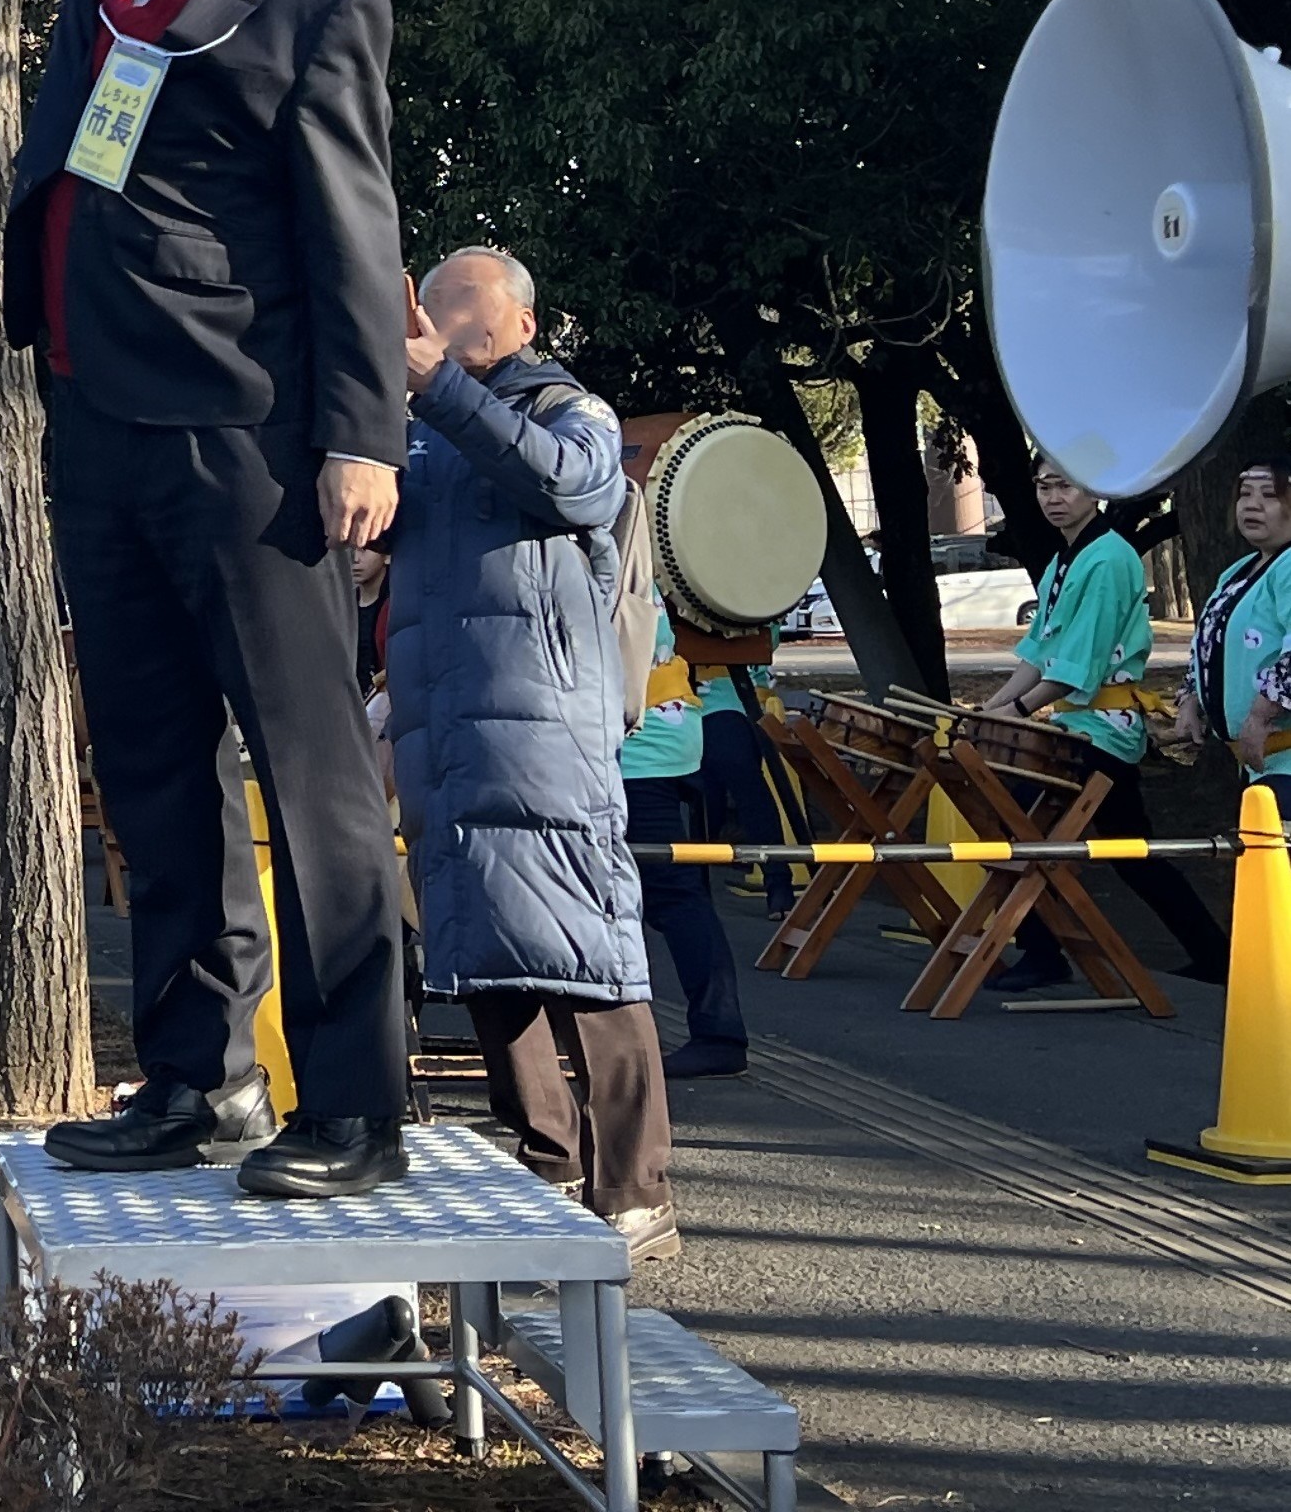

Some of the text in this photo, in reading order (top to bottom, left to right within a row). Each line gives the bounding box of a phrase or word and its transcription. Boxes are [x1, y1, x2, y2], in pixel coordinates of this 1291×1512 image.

[101, 83, 142, 109] しちょう
[86, 103, 136, 148] 市長
